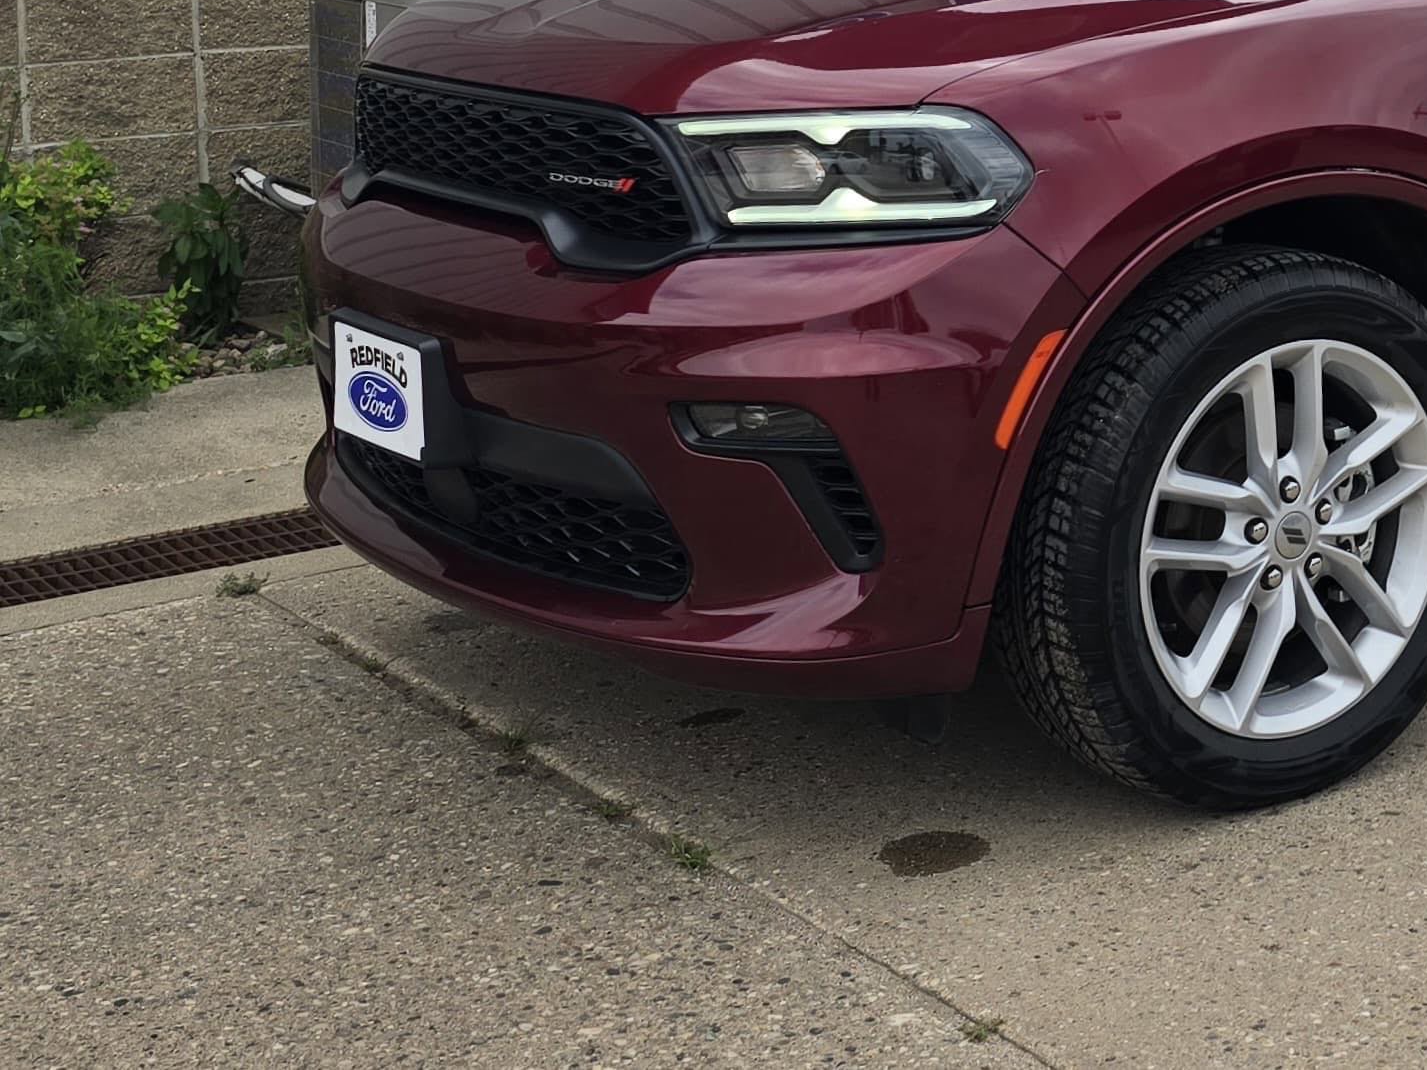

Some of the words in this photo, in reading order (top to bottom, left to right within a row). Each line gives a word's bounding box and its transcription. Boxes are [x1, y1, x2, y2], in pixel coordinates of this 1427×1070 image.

[549, 172, 622, 189] DODGE
[350, 345, 408, 389] REDFIELD
[359, 379, 397, 423] Ford
